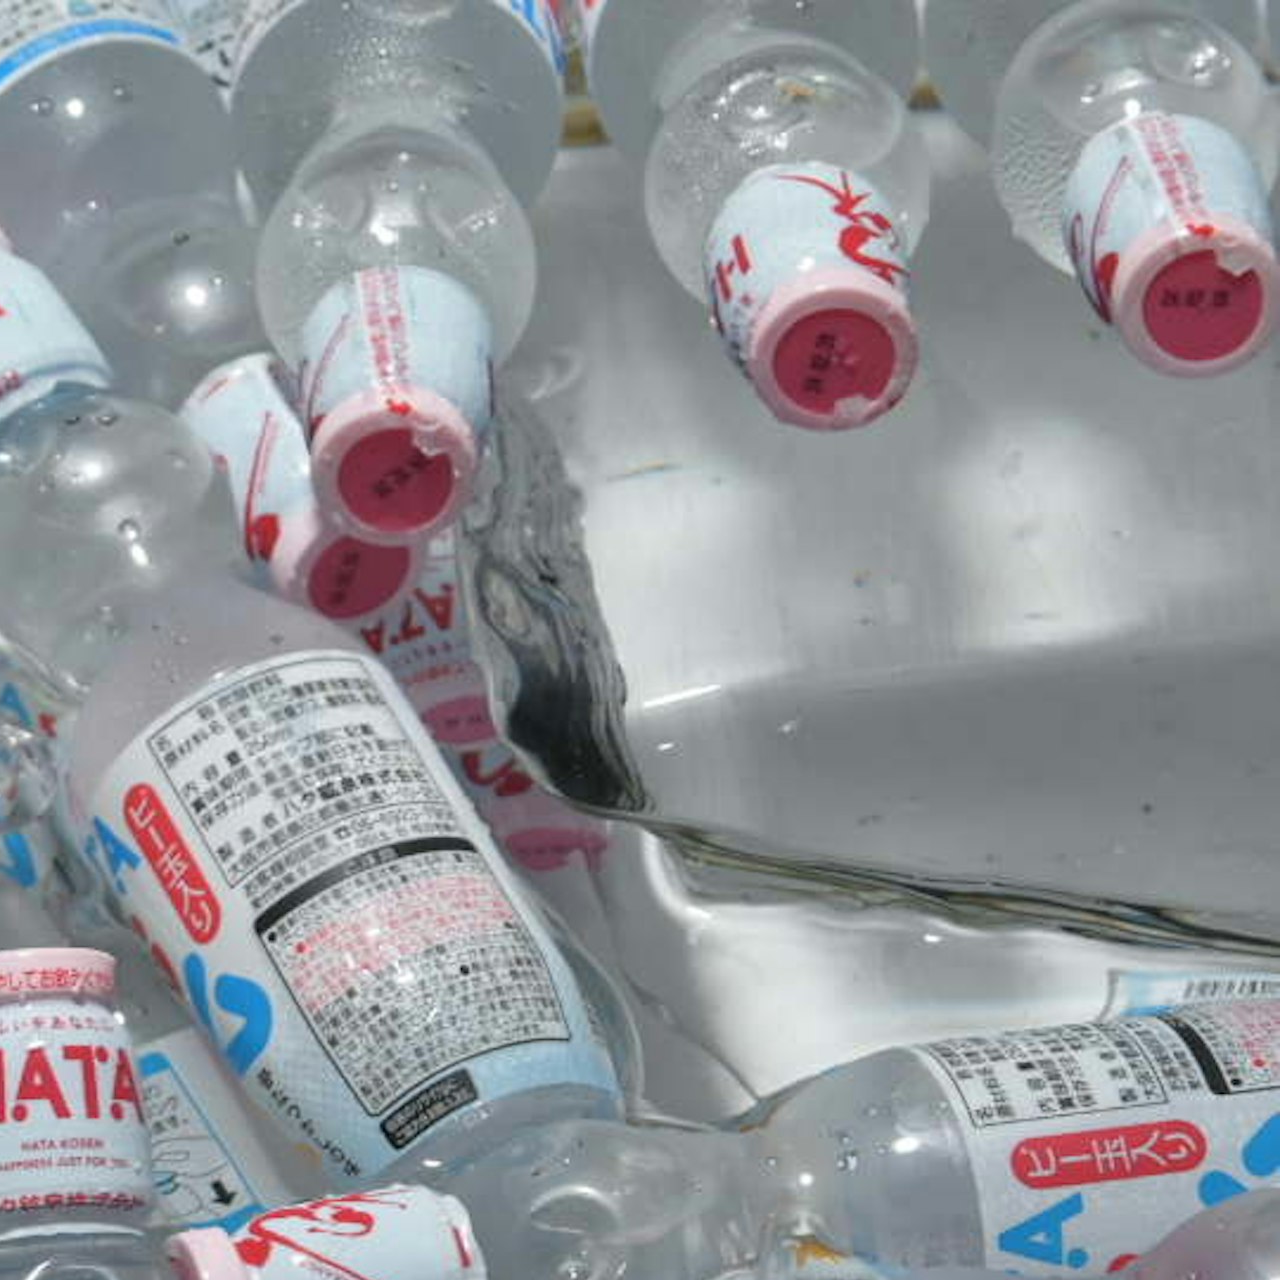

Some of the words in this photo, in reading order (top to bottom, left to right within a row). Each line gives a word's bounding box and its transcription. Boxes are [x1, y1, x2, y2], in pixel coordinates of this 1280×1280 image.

[1019, 1127, 1198, 1180] ビー玉入り
